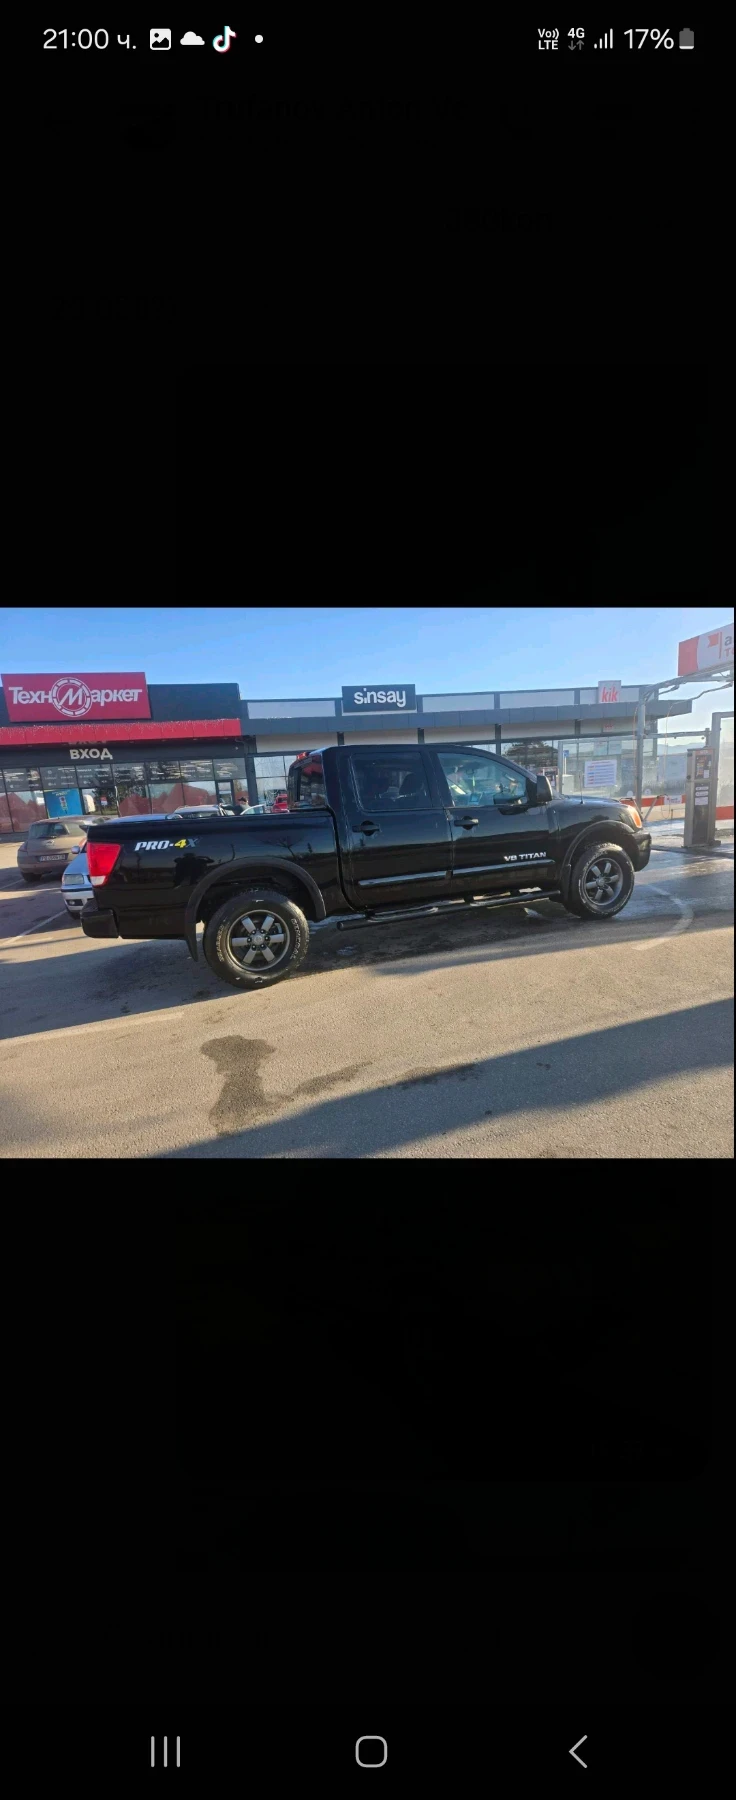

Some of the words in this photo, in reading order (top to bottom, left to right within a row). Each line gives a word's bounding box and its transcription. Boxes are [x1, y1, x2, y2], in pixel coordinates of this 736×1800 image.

[354, 688, 406, 707] sinsay
[602, 687, 618, 702] kik
[69, 748, 113, 760] ВХОД
[134, 838, 198, 851] PRO-4X
[519, 851, 547, 860] TITAN
